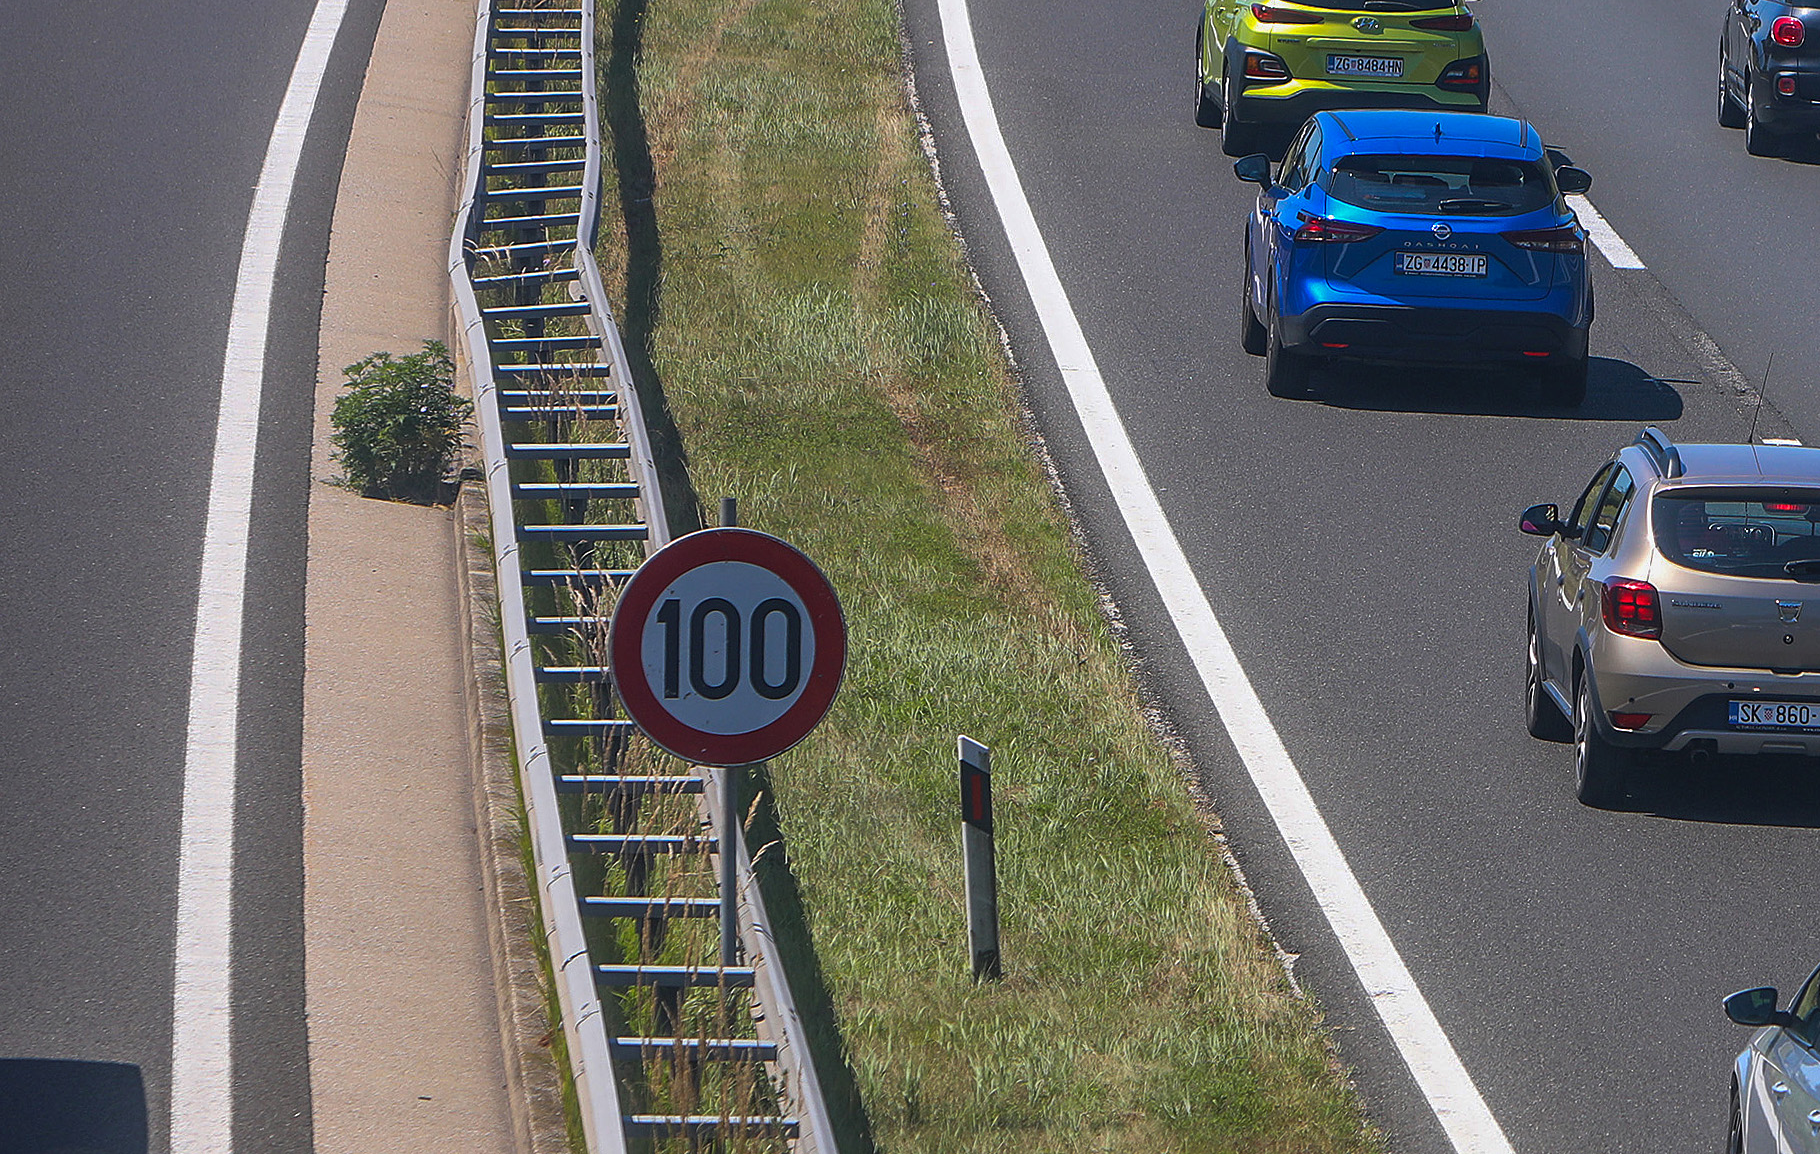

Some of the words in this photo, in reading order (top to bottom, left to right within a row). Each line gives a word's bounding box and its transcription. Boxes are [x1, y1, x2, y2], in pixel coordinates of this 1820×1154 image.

[1335, 56, 1351, 71] ZG
[1405, 255, 1423, 271] ZG
[656, 597, 802, 701] 100
[1740, 704, 1762, 723] SK
